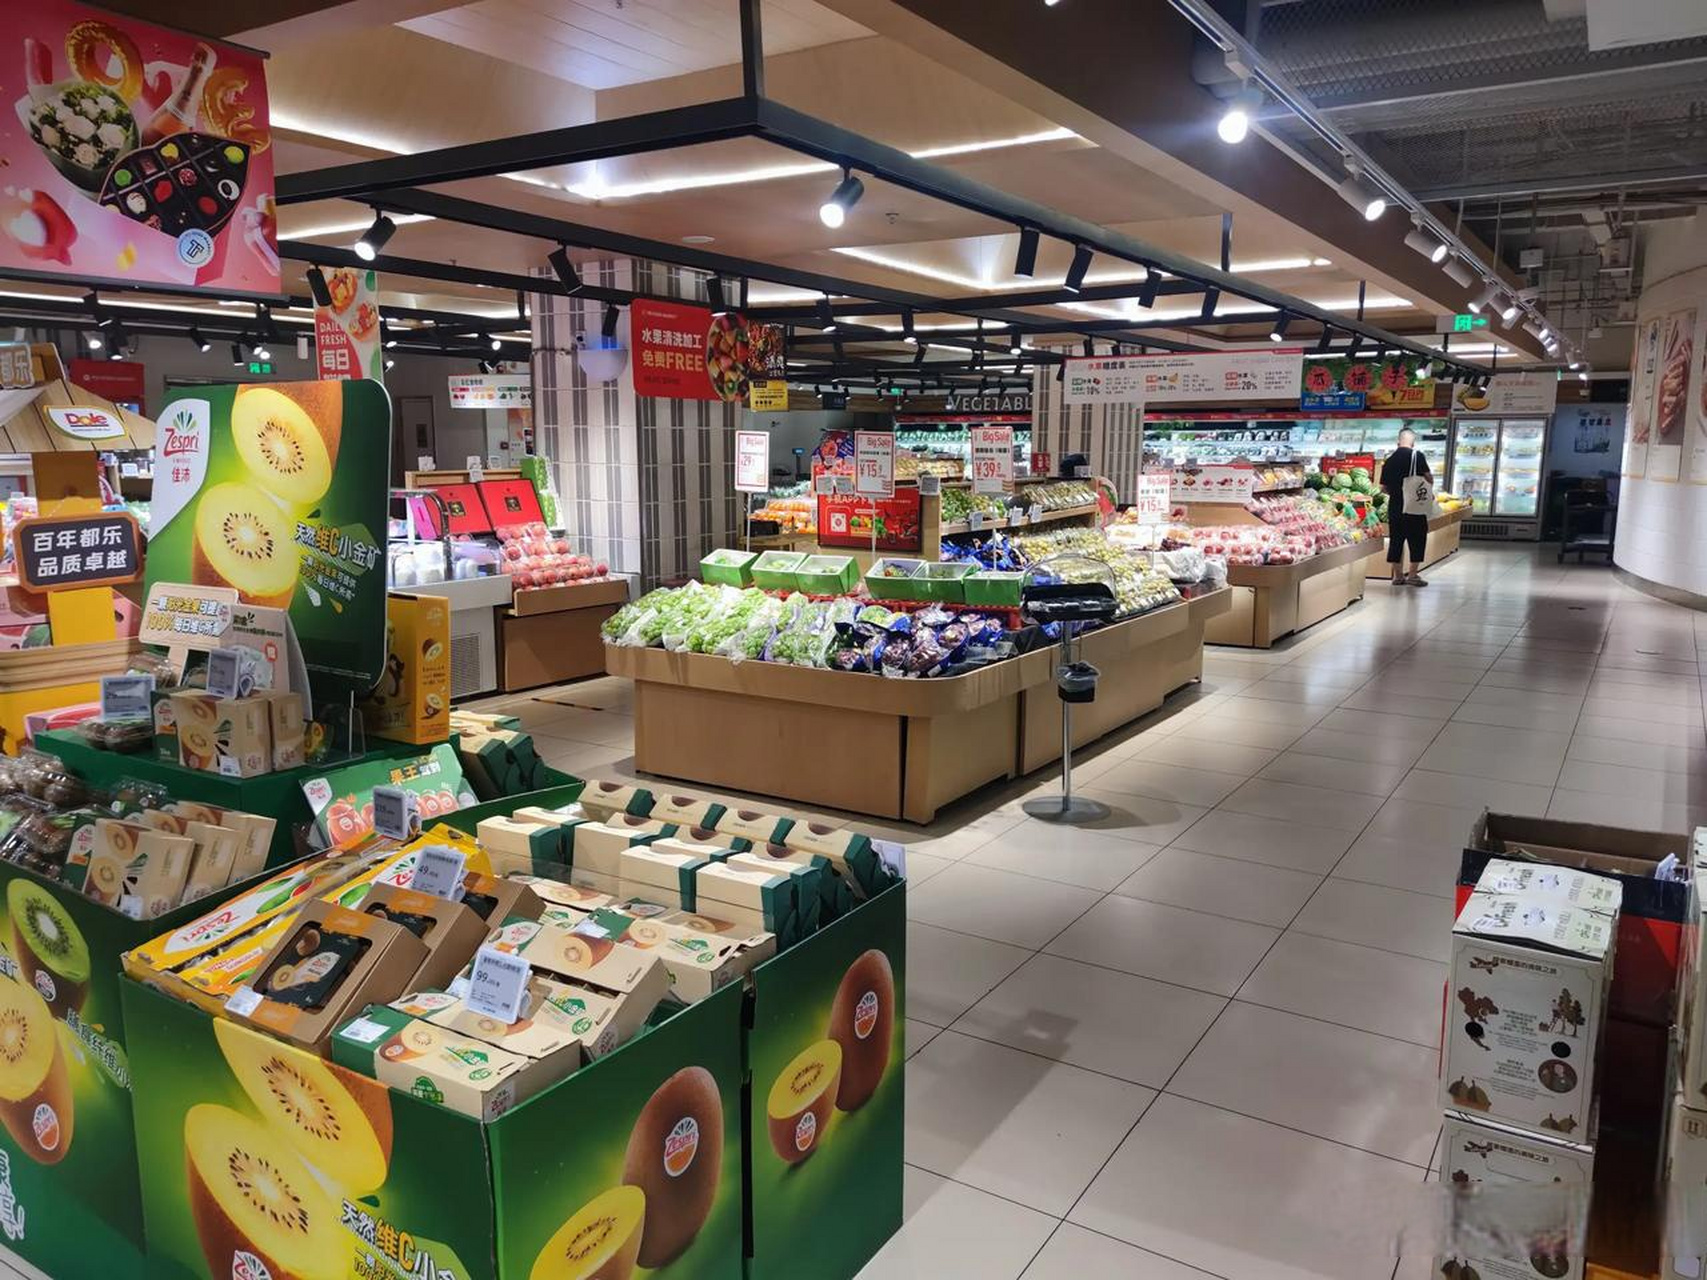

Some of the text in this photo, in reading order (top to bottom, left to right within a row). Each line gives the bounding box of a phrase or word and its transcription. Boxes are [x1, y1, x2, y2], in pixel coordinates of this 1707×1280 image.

[321, 334, 348, 346] FRESH
[641, 328, 703, 350] 水果清洗加工
[322, 348, 349, 370] 每日
[642, 350, 704, 371] 免费FREE
[64, 413, 108, 425] Dole
[163, 427, 200, 457] Zespri
[32, 524, 123, 553] 百年都乐
[36, 549, 127, 578] 品质卓越
[666, 1132, 699, 1155] Zespri
[341, 1197, 456, 1280] 天然维C小
